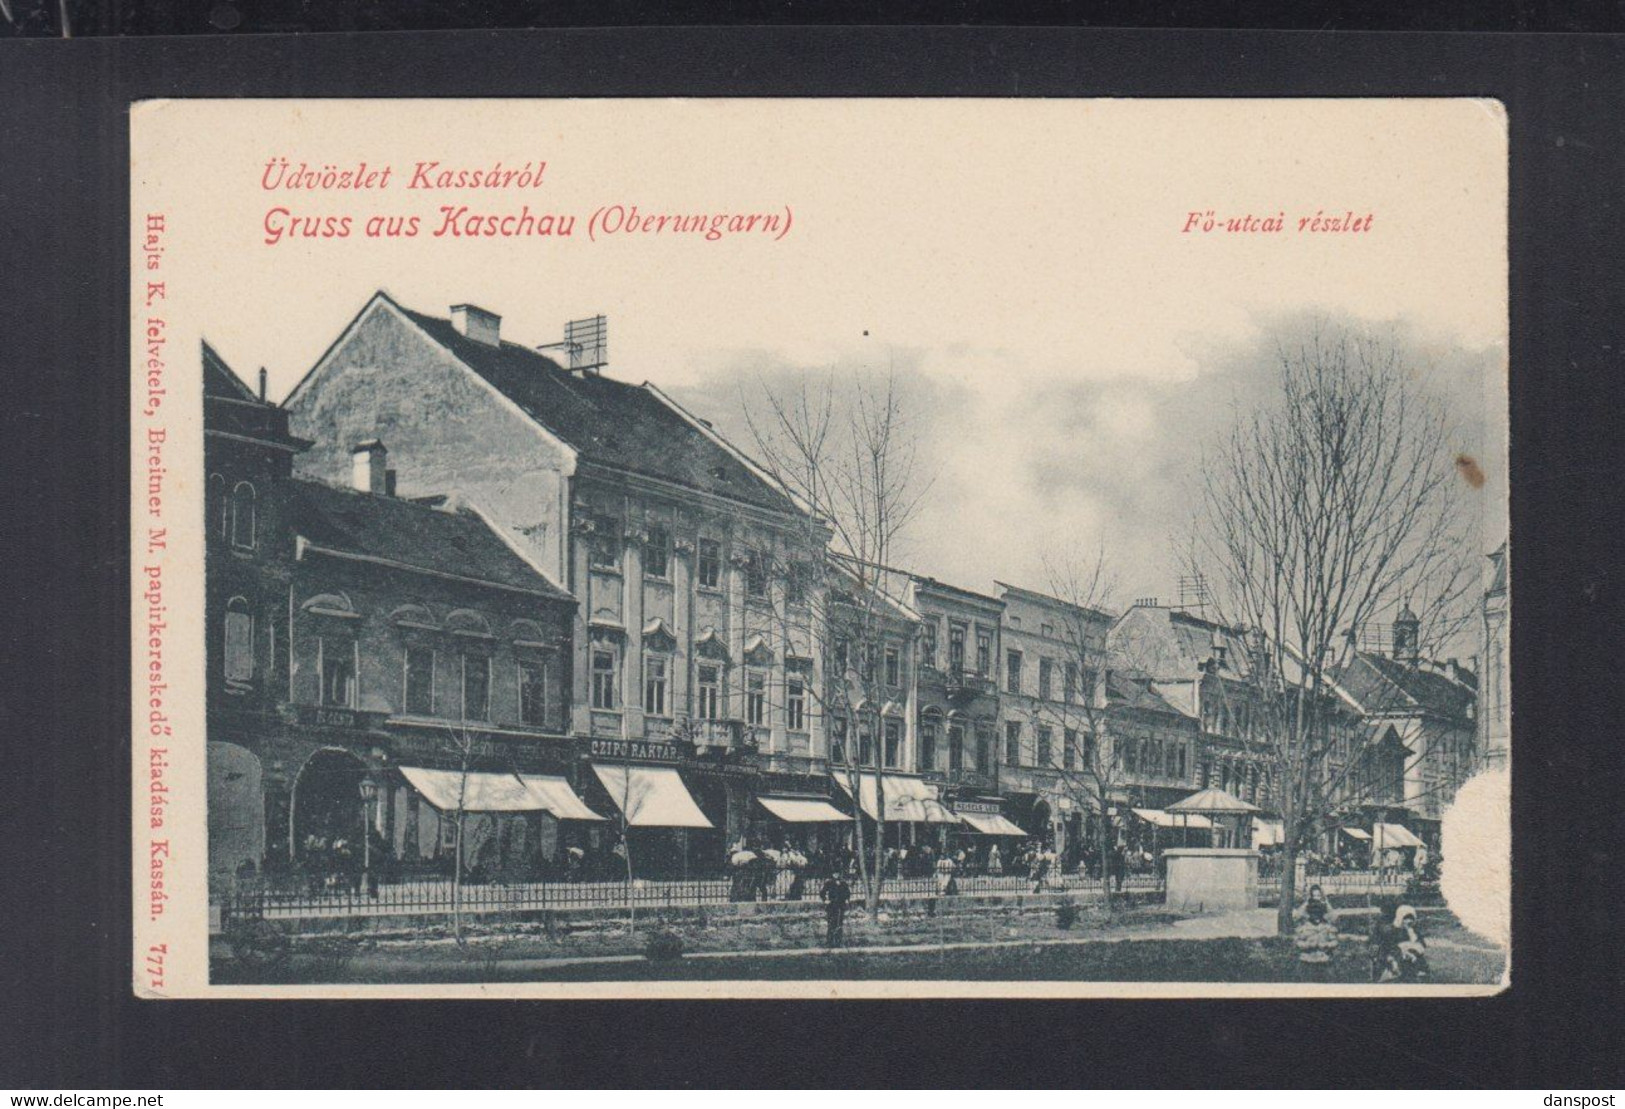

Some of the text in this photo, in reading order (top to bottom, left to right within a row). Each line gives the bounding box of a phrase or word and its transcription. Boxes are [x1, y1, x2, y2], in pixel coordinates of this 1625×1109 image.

[261, 158, 547, 191] Üdvözlet Kassáról
[143, 213, 167, 270] Hajts
[263, 204, 794, 246] Gruss aus Kaschau (Oberungarn)
[1297, 210, 1374, 233] részlet
[145, 281, 166, 307] K.
[145, 317, 167, 417] felvétele,
[147, 428, 167, 517] Breitner
[148, 528, 166, 554] M.
[149, 748, 169, 829] kiadása
[150, 840, 169, 922] Kassán.
[146, 944, 168, 988] 7771
